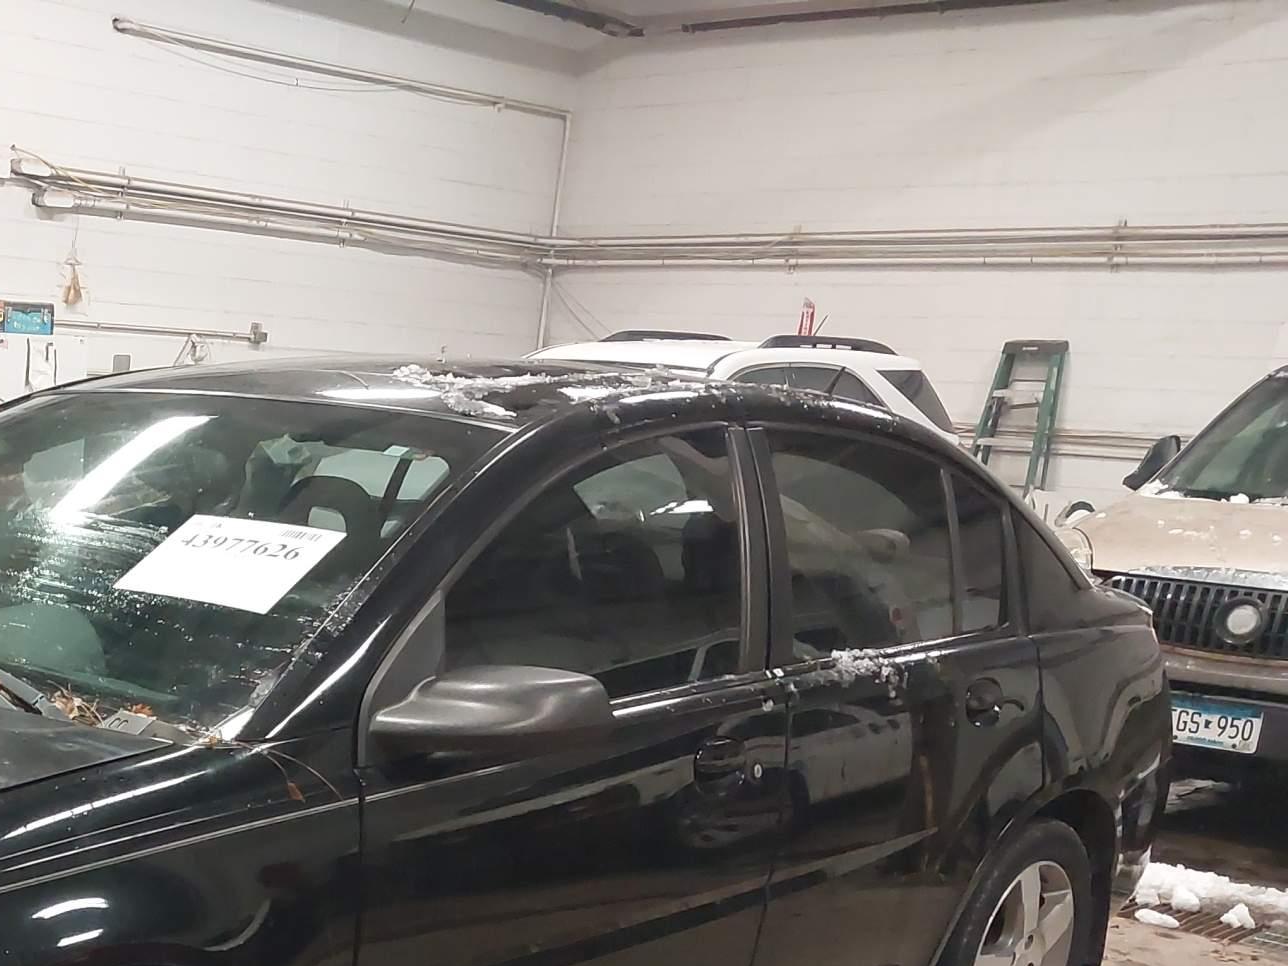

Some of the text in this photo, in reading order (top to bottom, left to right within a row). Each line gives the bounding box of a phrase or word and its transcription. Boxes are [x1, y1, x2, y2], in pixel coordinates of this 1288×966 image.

[181, 533, 304, 561] 43977626
[1176, 709, 1254, 741] GS 950
